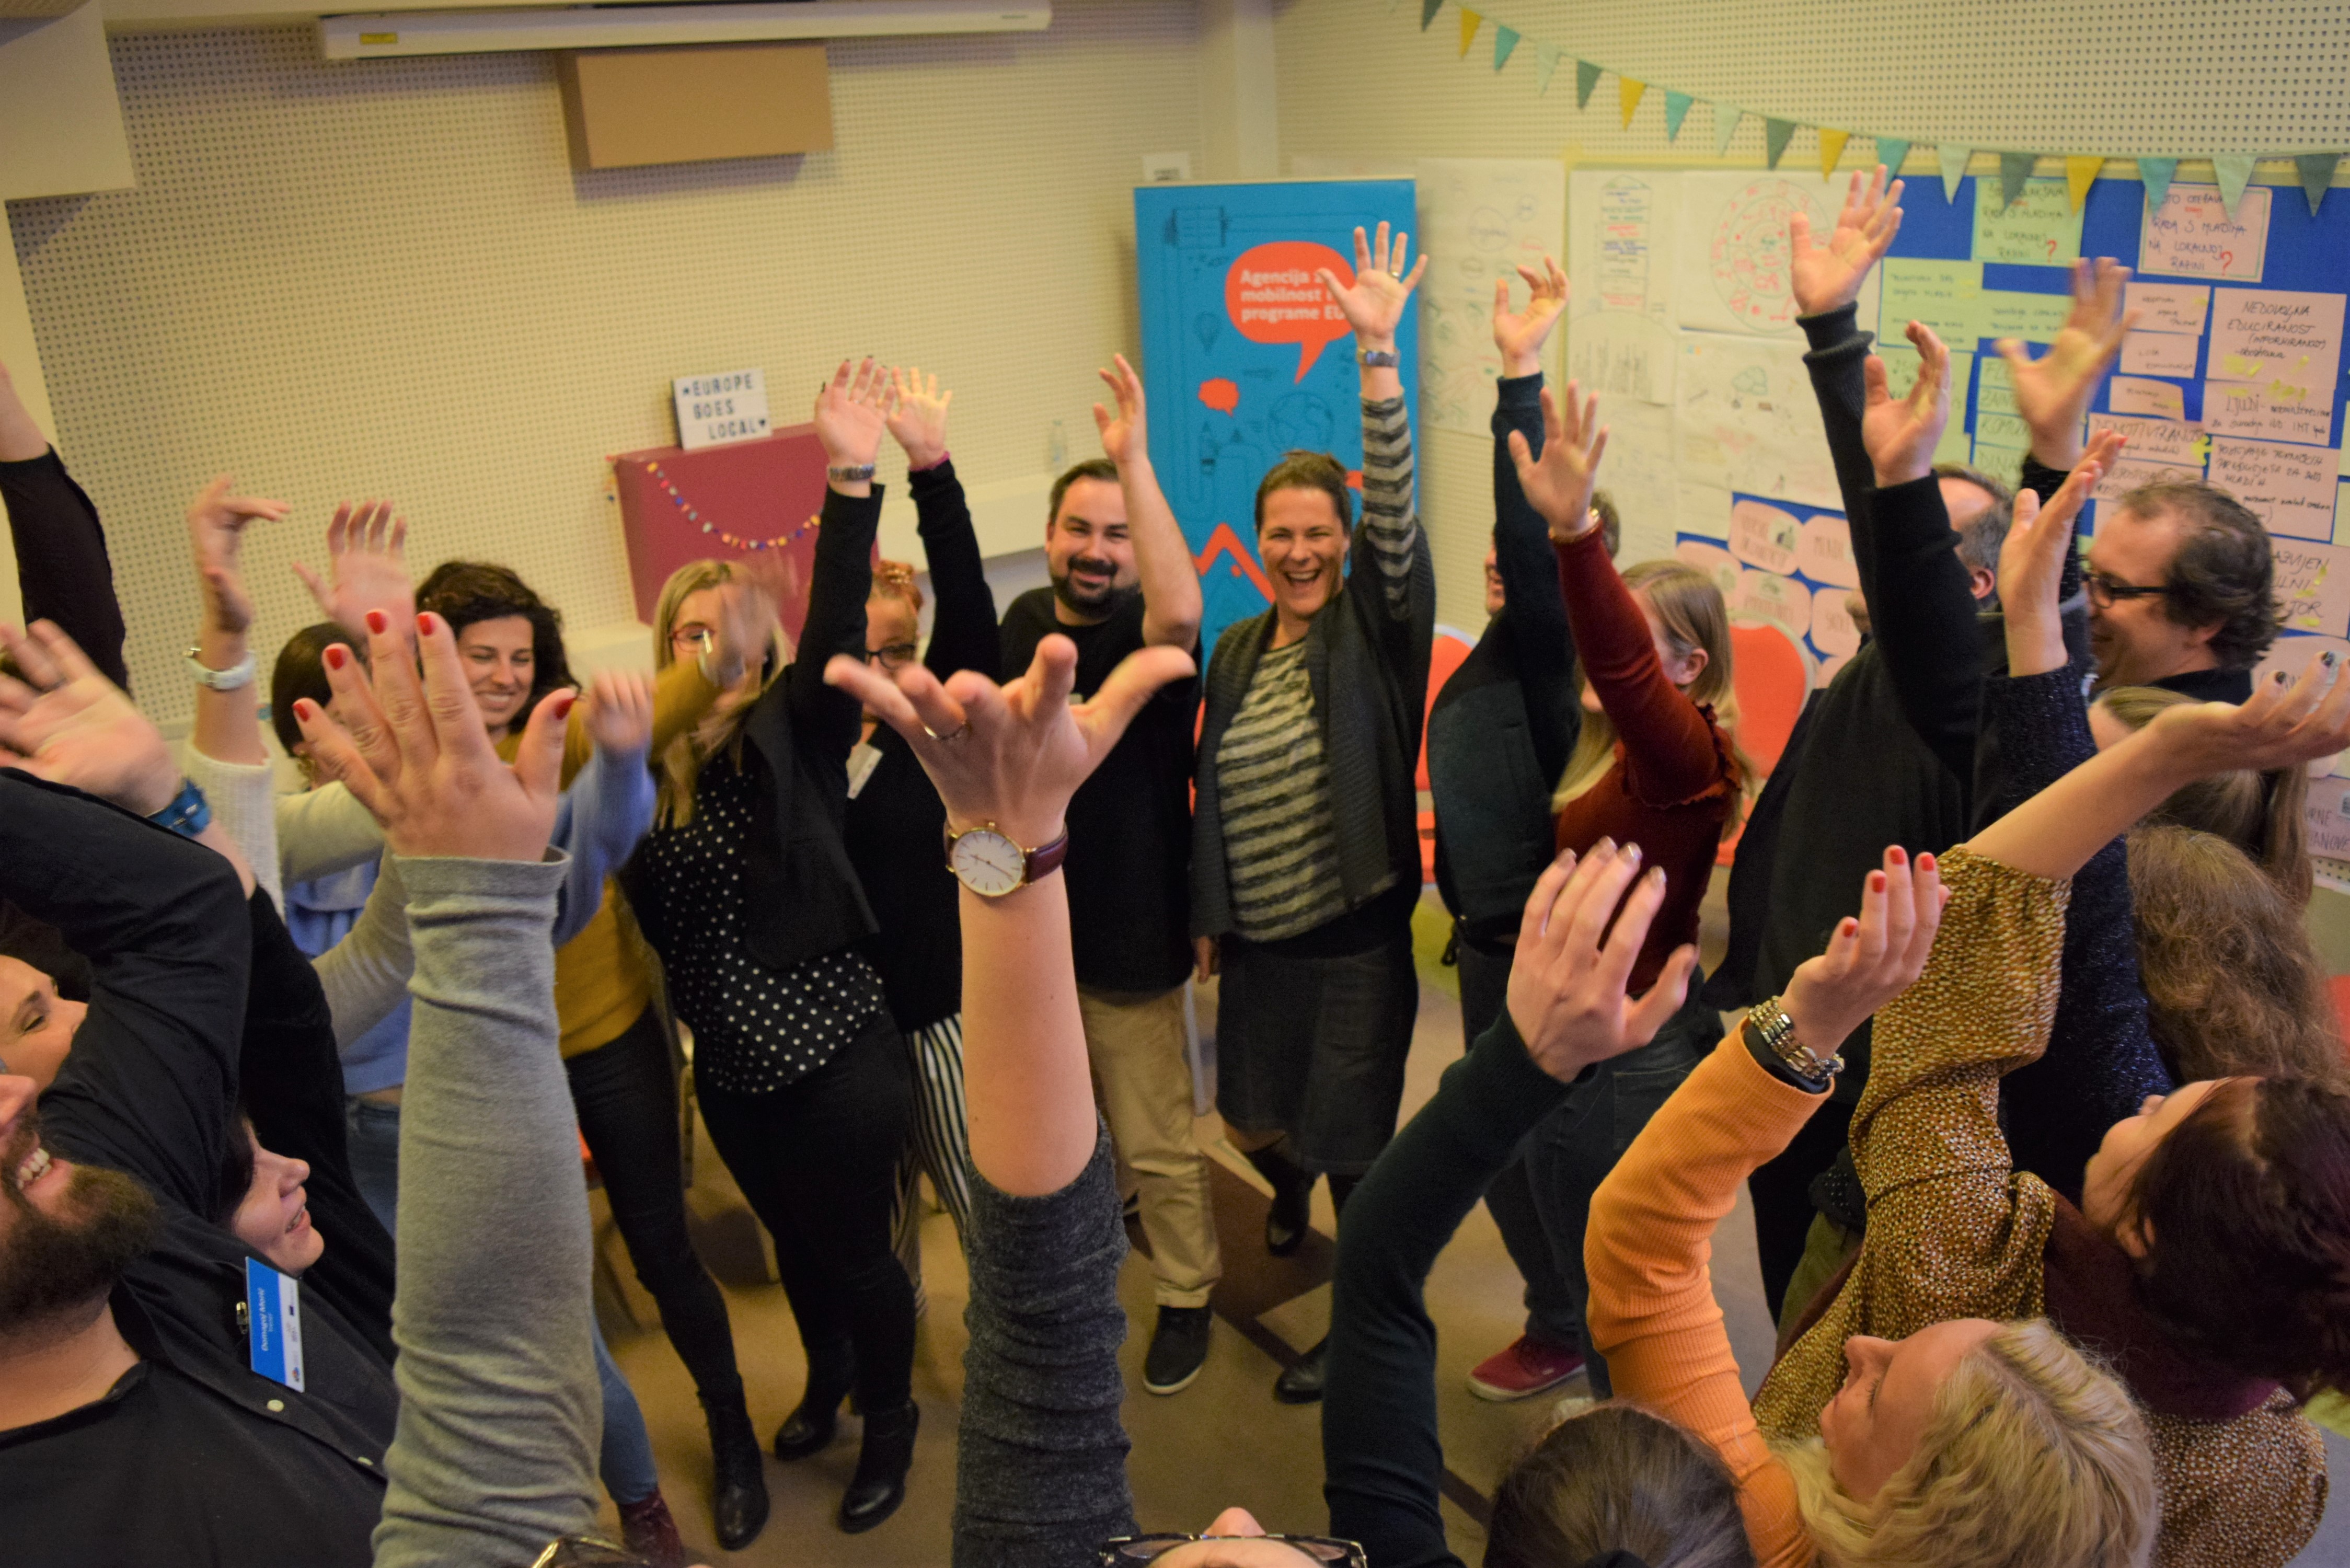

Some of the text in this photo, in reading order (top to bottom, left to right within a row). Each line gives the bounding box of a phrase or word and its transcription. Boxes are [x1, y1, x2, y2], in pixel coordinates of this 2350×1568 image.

[1240, 269, 1309, 287] Agencija
[1240, 287, 1322, 302] mobilnost
[1241, 307, 1320, 324] programe
[692, 372, 753, 396] EUROPE
[694, 398, 735, 420] GOES
[708, 418, 756, 440] LOCAL
